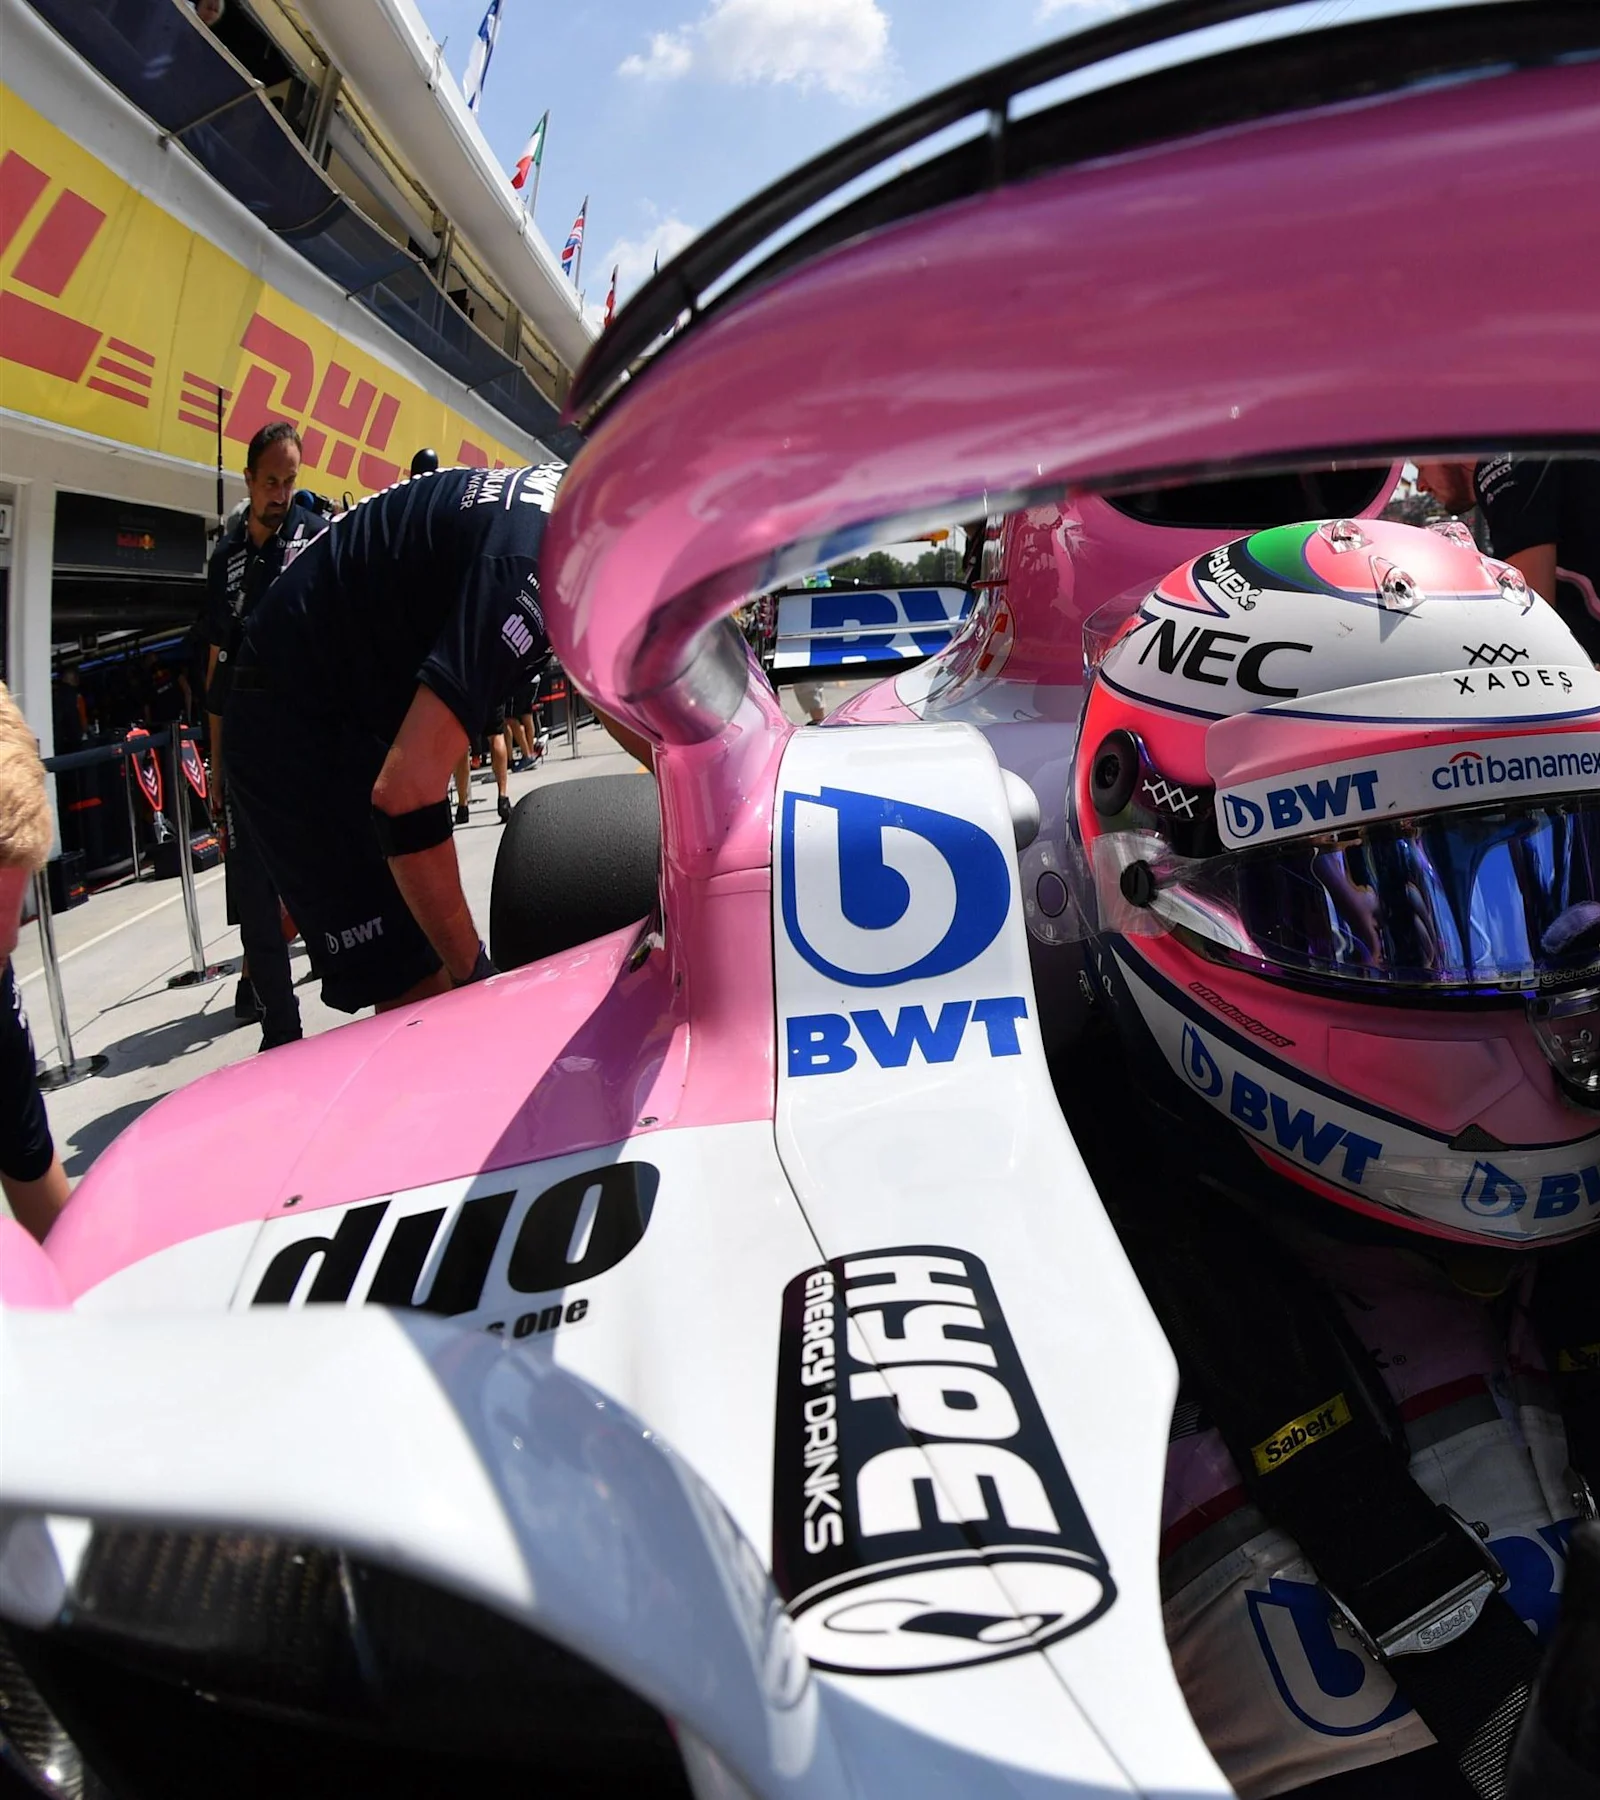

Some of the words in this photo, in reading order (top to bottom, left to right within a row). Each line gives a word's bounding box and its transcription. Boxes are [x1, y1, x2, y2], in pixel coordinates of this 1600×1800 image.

[1208, 546, 1262, 606] PEMEX
[502, 613, 534, 655] duo
[1138, 619, 1313, 698] NEC
[1453, 669, 1574, 696] XADES
[1269, 770, 1379, 830] BWT
[341, 916, 384, 950] BWT
[786, 996, 1029, 1077] BWT
[1229, 1070, 1383, 1185] BWT
[250, 1160, 661, 1319] duo
[514, 1299, 589, 1339] one
[800, 1270, 836, 1387] ENERGY
[843, 1254, 1062, 1538] HYPE
[1264, 1409, 1339, 1464] Sabelt
[803, 1394, 845, 1554] DRINKS
